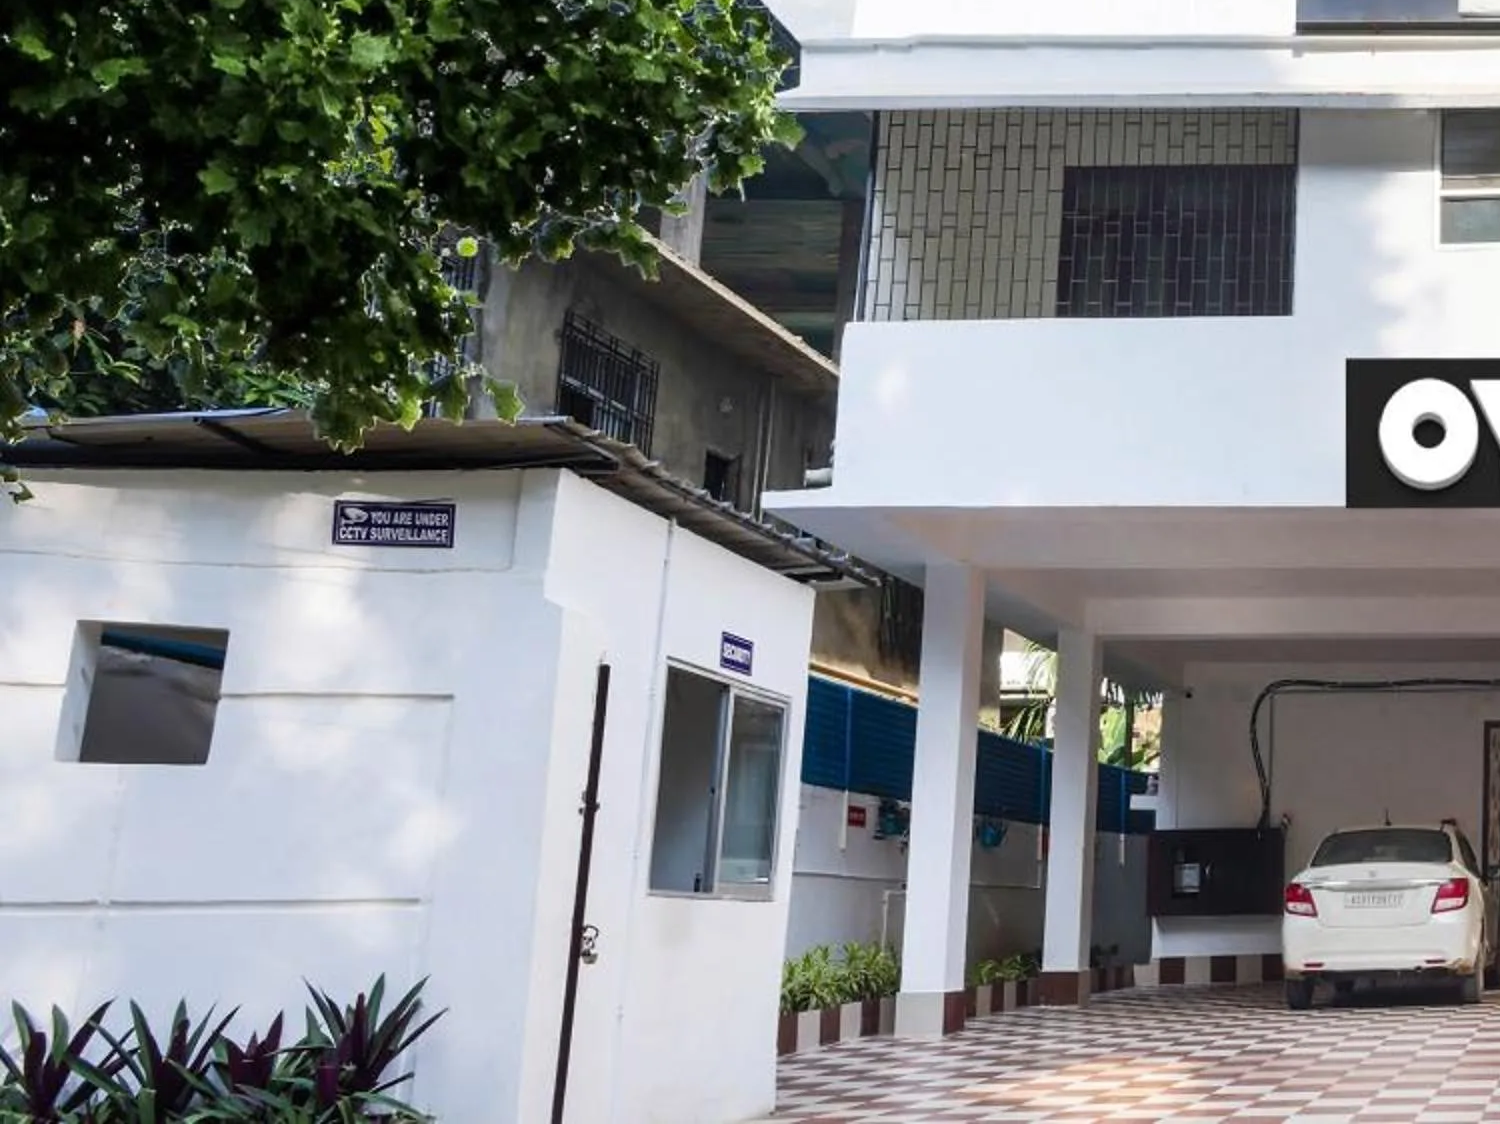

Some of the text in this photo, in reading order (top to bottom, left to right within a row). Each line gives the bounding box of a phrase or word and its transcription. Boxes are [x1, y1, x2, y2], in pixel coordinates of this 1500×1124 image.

[370, 511, 449, 526] YOU ARE UNDER
[339, 526, 449, 543] CCTV SURVEILLANCE
